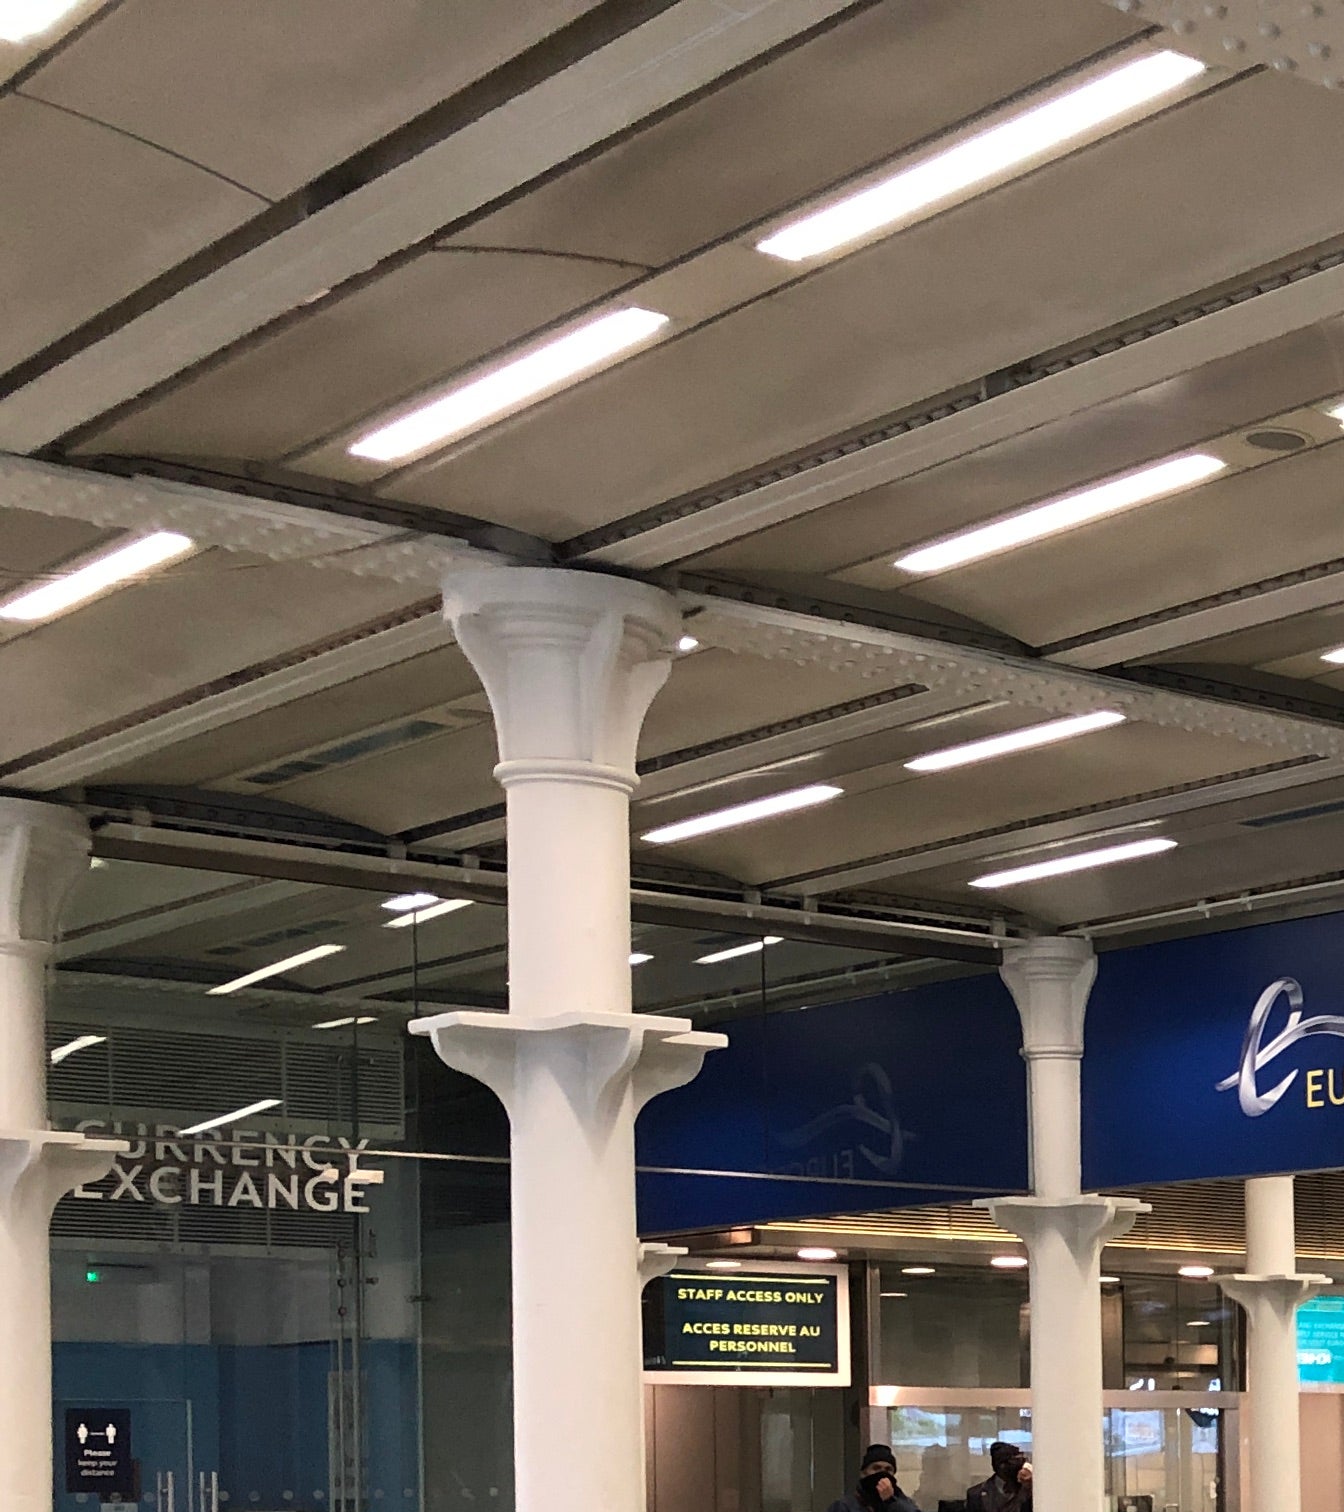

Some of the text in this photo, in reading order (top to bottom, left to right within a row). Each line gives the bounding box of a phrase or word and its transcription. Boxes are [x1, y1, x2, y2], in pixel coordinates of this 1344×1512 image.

[677, 1288, 824, 1304] STAFF ACCESS ONLY
[682, 1323, 821, 1337] ACCES RESERVE AU
[709, 1340, 797, 1353] PERSONNEL
